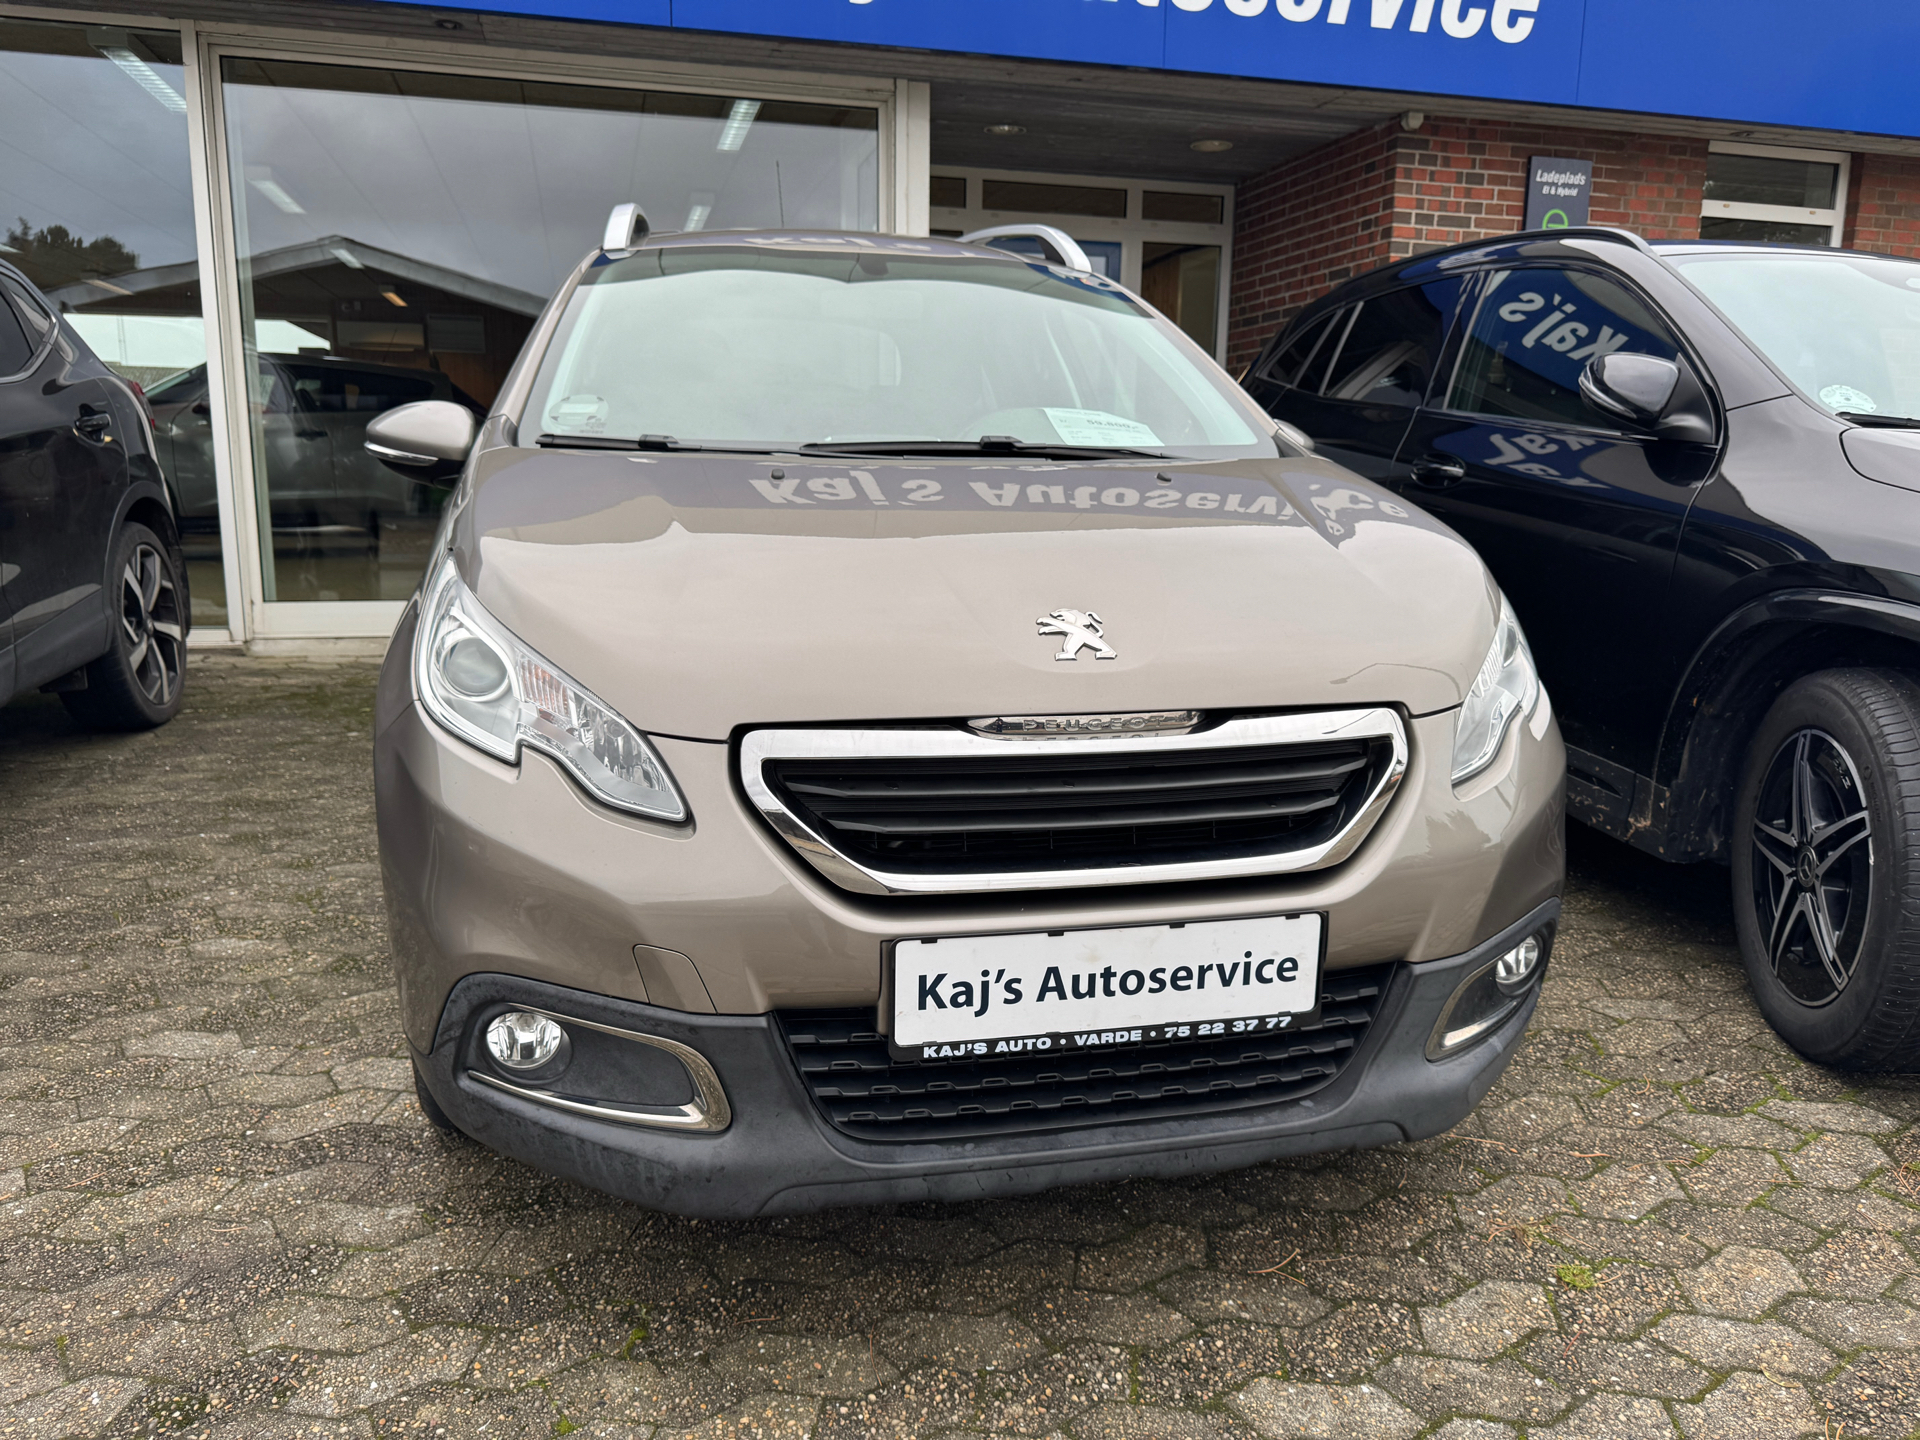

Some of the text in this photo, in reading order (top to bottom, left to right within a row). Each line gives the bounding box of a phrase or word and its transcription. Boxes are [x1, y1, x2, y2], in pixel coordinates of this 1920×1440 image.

[1536, 169, 1586, 185] Ladeplads
[1557, 186, 1578, 197] Hybrid
[1022, 715, 1165, 732] PEUGEOT
[918, 951, 1300, 1018] Kaj's Autoservice
[923, 1016, 1292, 1058] KAJ'S AUTO VARDE 75 22 37 77
